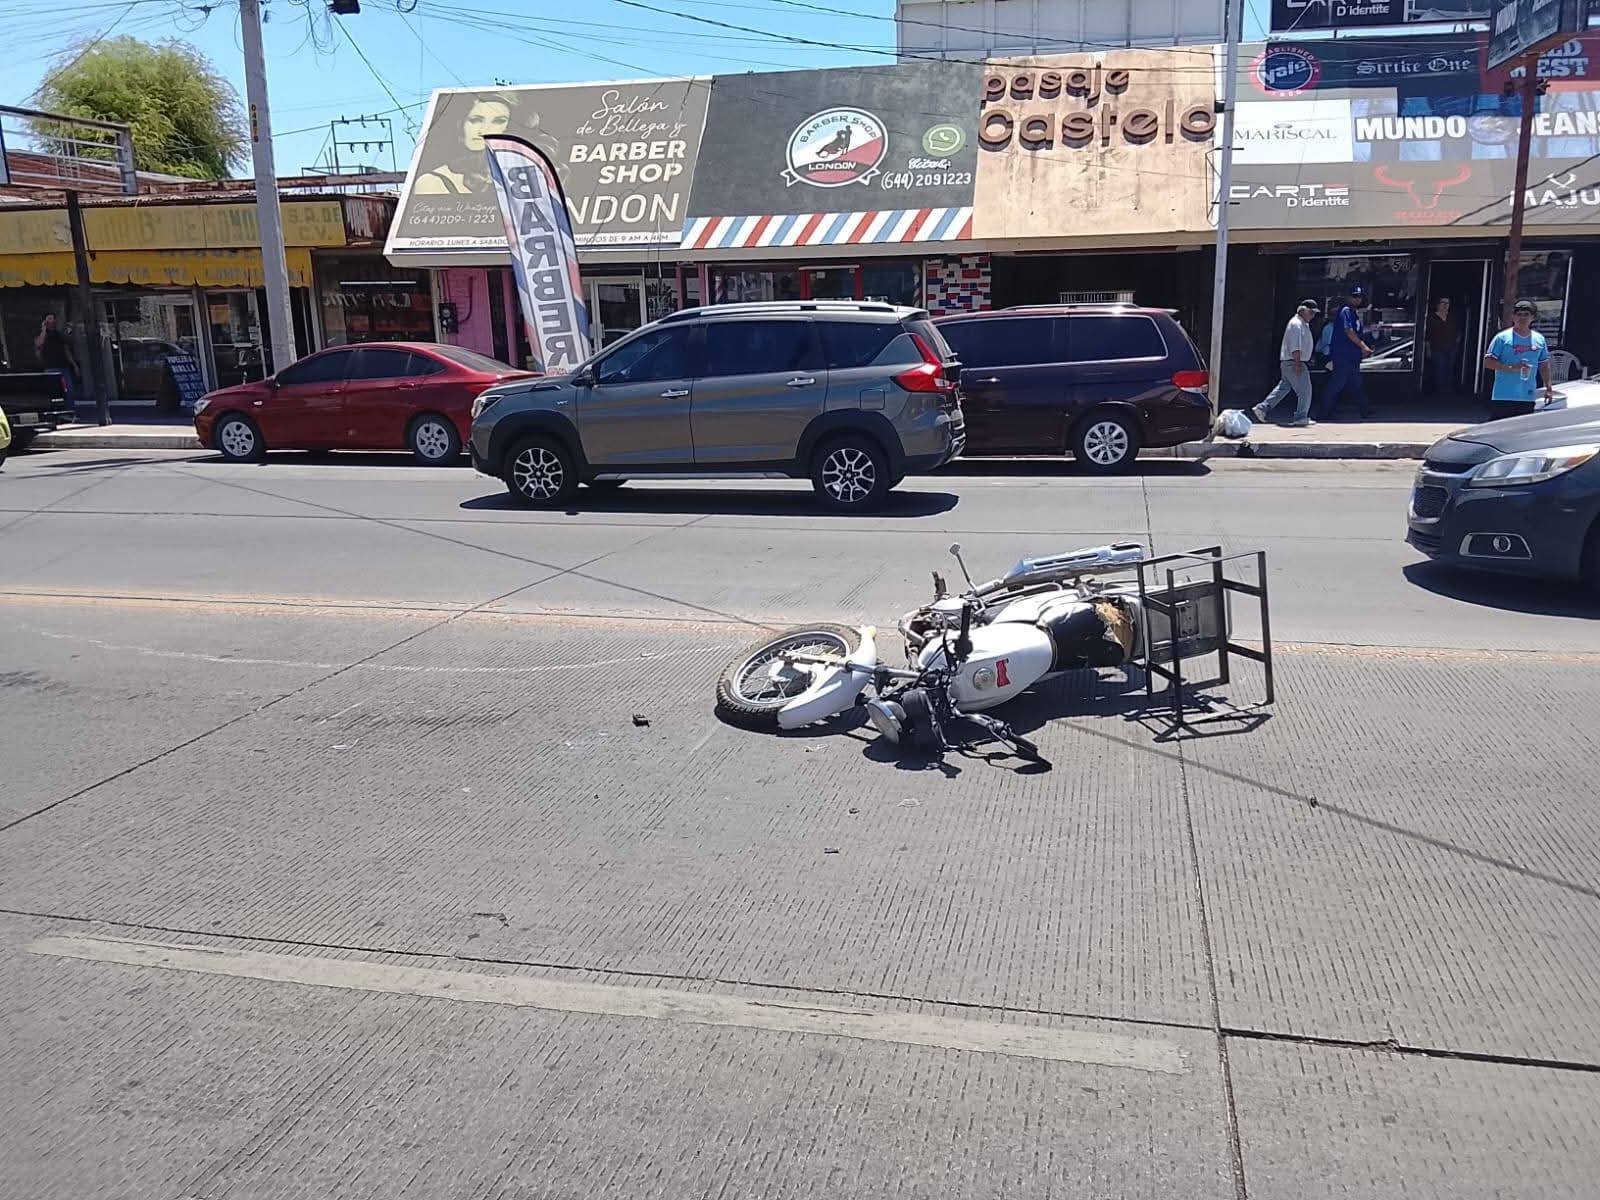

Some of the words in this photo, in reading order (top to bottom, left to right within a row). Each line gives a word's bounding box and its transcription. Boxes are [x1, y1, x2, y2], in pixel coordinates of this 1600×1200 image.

[1356, 61, 1421, 75] Strike
[1426, 57, 1471, 73] One
[981, 62, 1129, 110] pasaje
[576, 121, 595, 135] de
[800, 115, 849, 143] BARBER
[850, 117, 878, 139] SHOP
[1233, 128, 1338, 140] MARISCAL
[1356, 115, 1467, 140] MUNDO
[1517, 111, 1600, 136] EAN
[569, 140, 687, 163] BARBER
[598, 163, 683, 184] SHOP
[808, 161, 857, 171] LONDON
[881, 170, 914, 190] (644)
[915, 172, 972, 187] 2091223
[1228, 183, 1349, 198] CARTE
[566, 193, 680, 225] NDON
